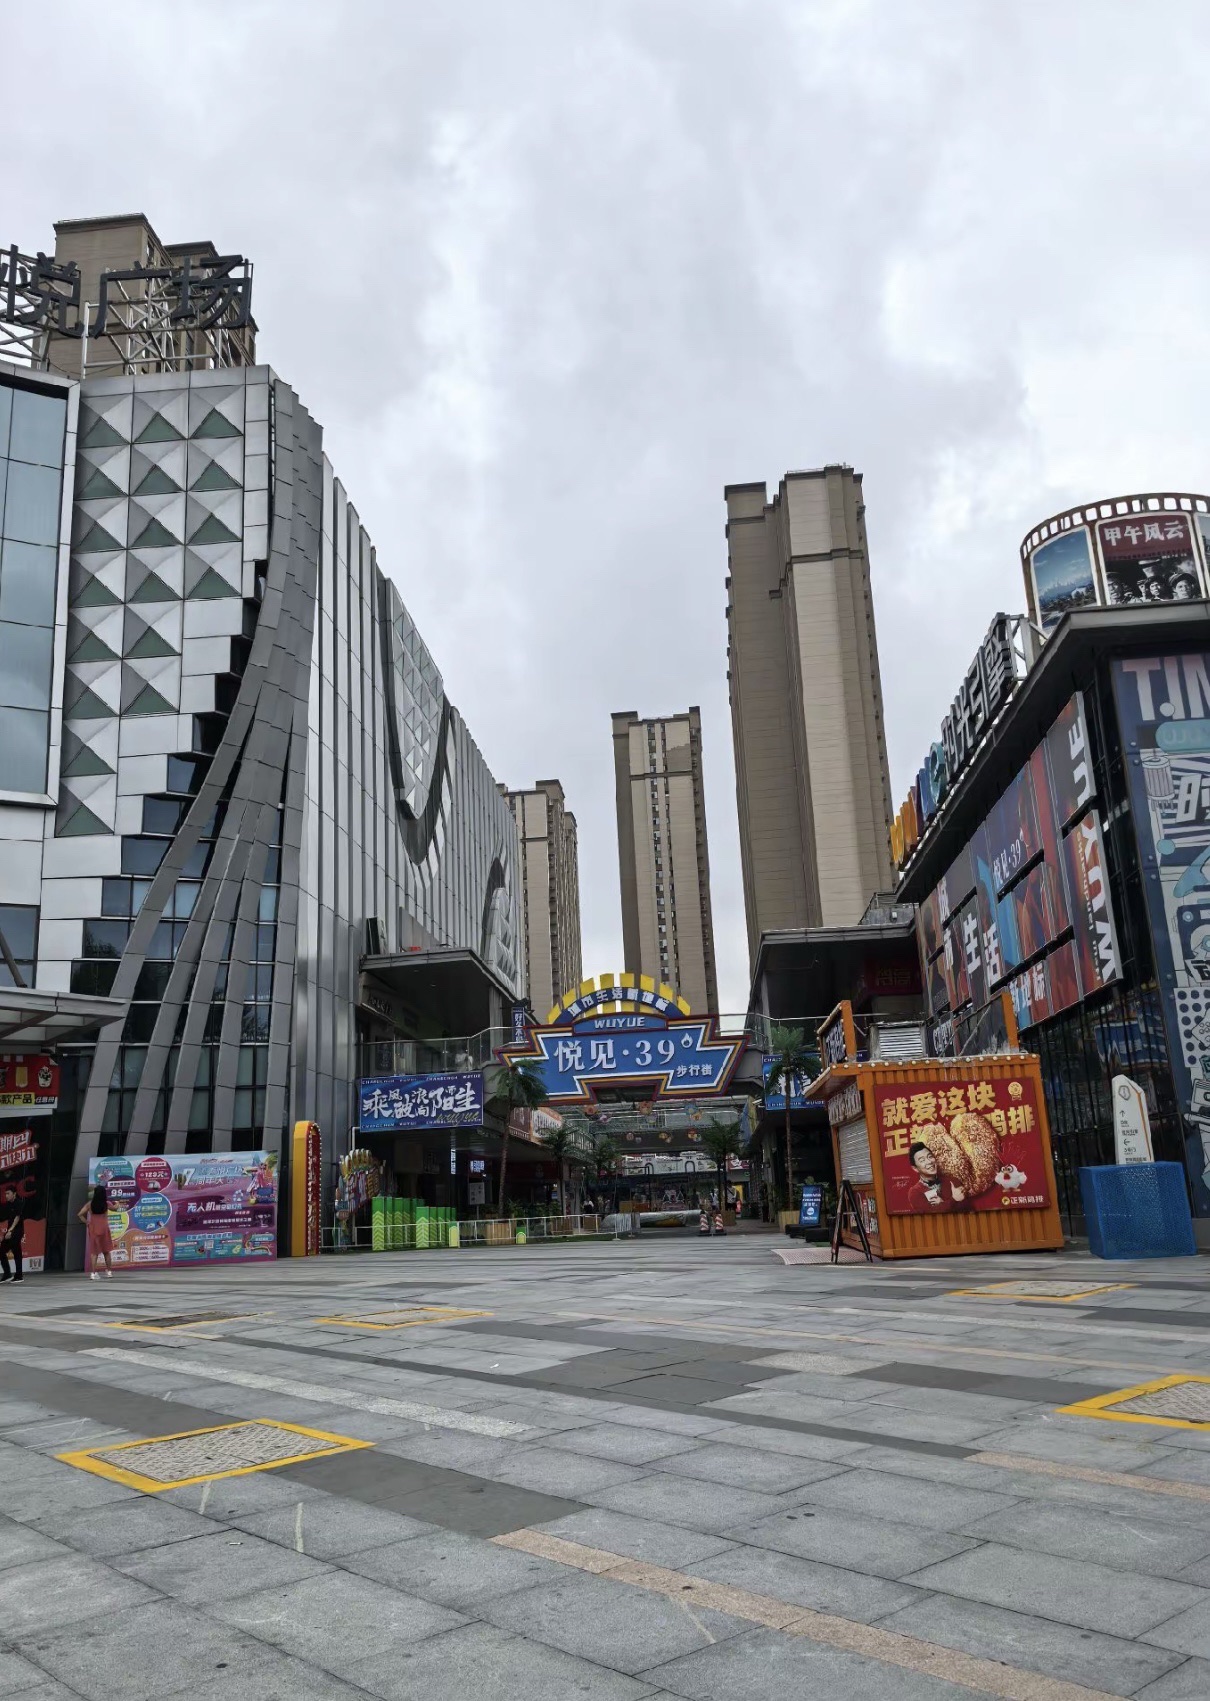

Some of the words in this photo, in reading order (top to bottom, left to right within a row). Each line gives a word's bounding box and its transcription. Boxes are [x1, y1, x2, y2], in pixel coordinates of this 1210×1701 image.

[1104, 520, 1184, 546] 甲午风云
[594, 1017, 646, 1029] WUYUE
[677, 1064, 713, 1077] 步行街
[881, 1081, 997, 1127] 就爱这块
